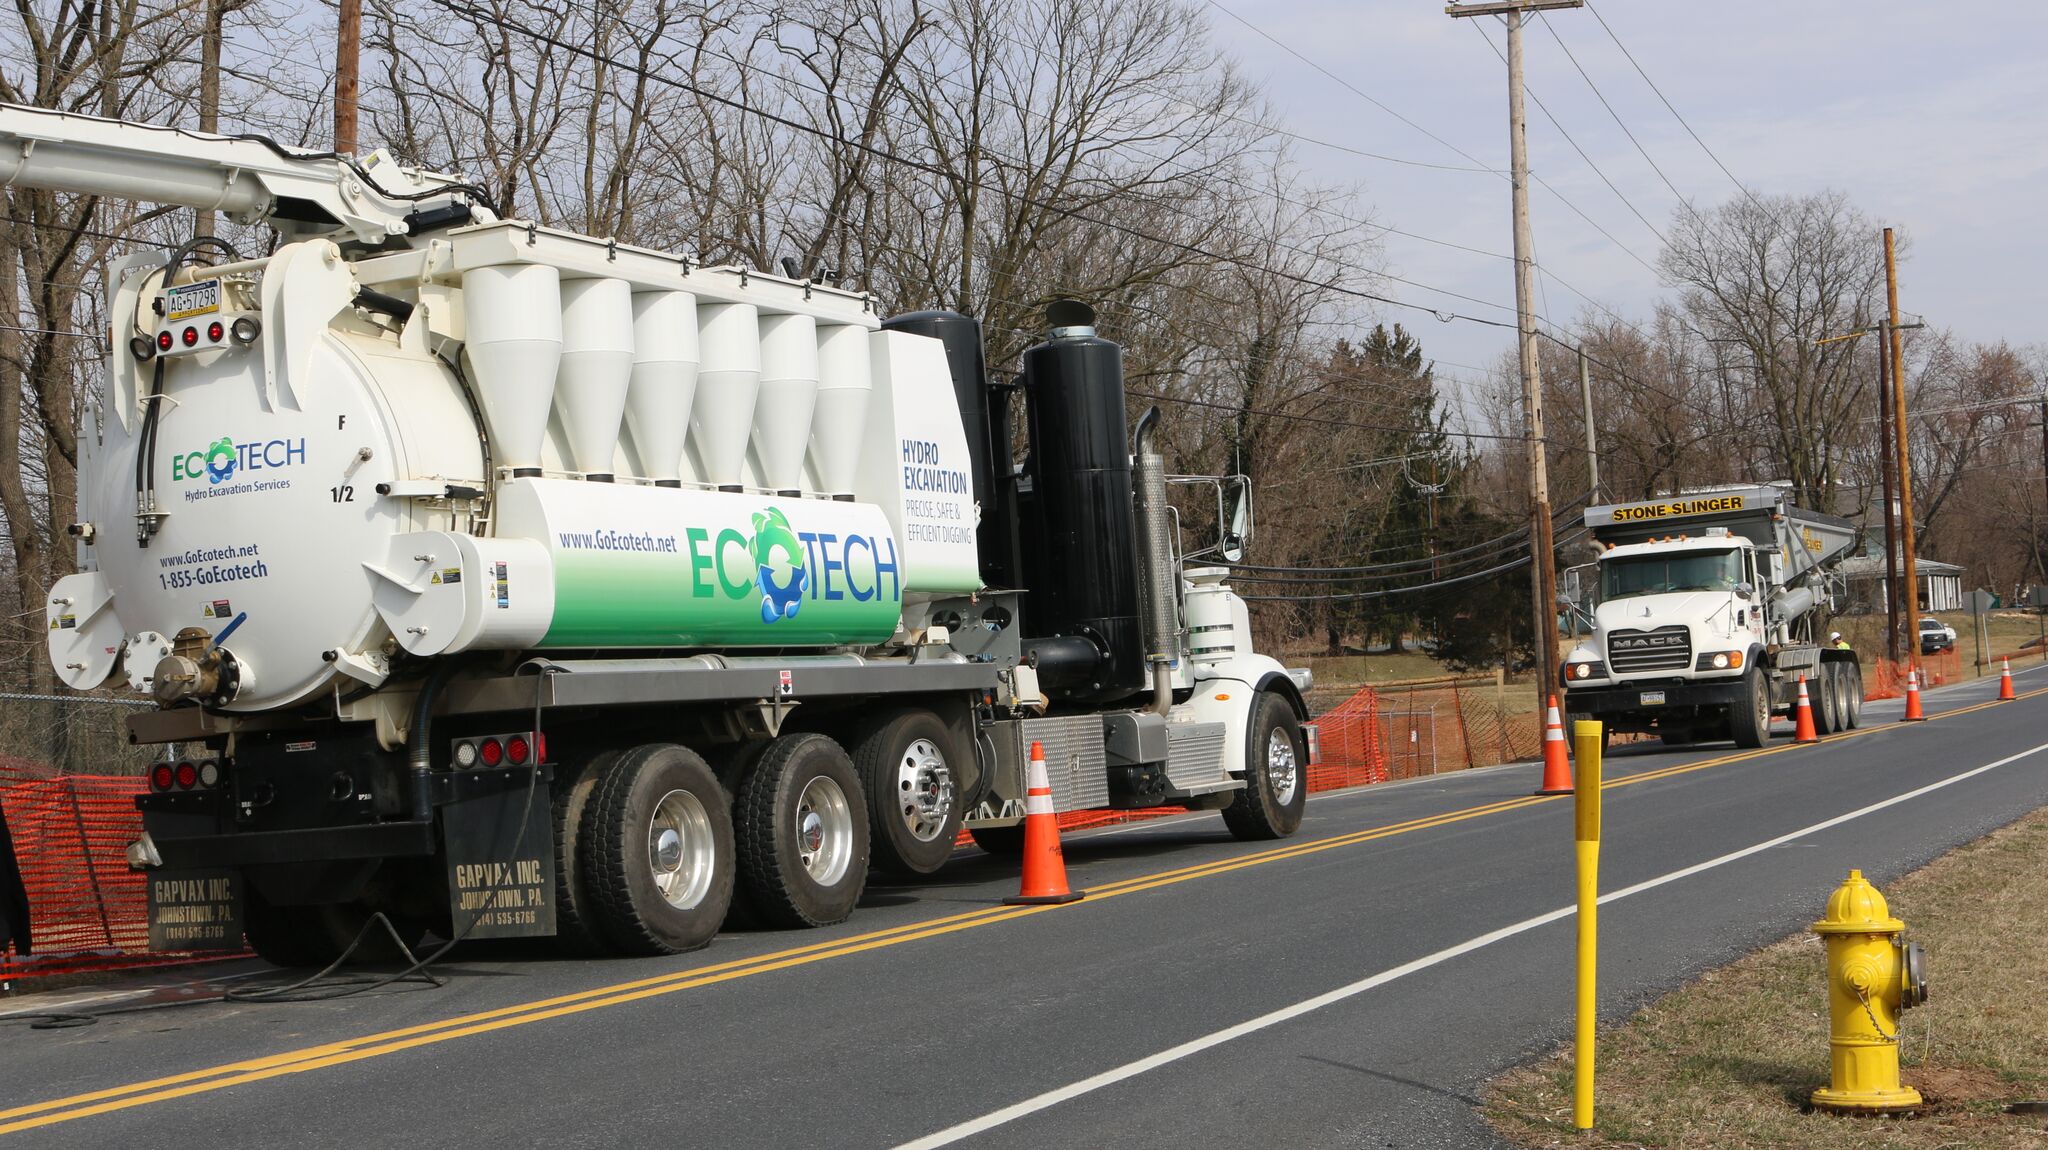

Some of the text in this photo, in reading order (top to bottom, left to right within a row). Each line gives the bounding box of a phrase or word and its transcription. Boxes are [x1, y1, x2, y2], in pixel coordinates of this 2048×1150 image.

[338, 415, 346, 430] F
[172, 437, 305, 484] ECOTECH
[902, 439, 939, 466] HYDRO
[185, 478, 291, 503] Hydro Excavation Services
[904, 466, 967, 494] EXCAVATION
[330, 485, 354, 503] 1/2
[906, 499, 961, 520] PRECISE, SAFE &
[1613, 496, 1743, 521] STONE SLINGER
[559, 529, 677, 553] www.GoEcotech.net
[908, 523, 972, 545] EFFICIENT DIGGING
[159, 543, 259, 568] www.GoEcotech.net
[685, 507, 900, 624] ECOTECH
[159, 560, 268, 590] 1-855-GoEcotech
[1613, 636, 1684, 648] MACK
[456, 860, 545, 888] GAPVAX INC.
[155, 878, 234, 903] GAPVAX INC.
[528, 887, 545, 906] PA.
[156, 905, 234, 924] JOHNSTOWN, PA.
[497, 911, 536, 925] 535-6766
